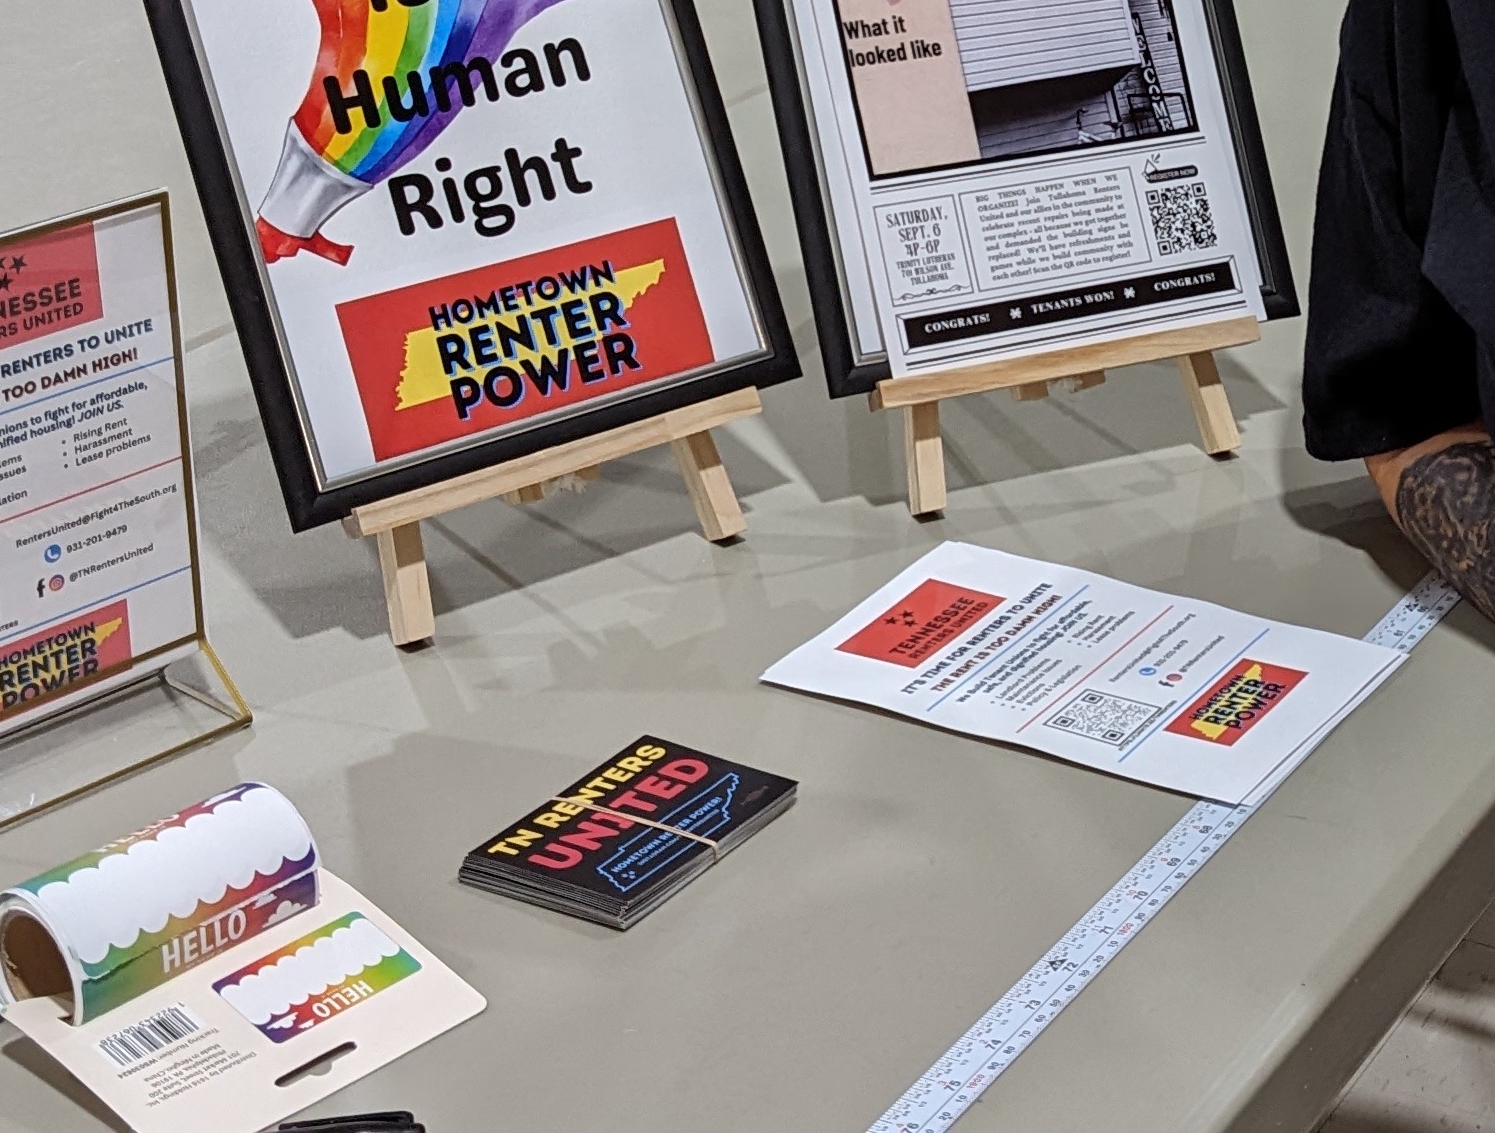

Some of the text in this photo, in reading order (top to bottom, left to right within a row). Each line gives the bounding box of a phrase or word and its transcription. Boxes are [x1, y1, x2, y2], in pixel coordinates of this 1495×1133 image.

[842, 15, 906, 40] What it
[848, 39, 941, 67] looked like
[322, 36, 591, 135] Human
[389, 137, 592, 236] Right
[975, 174, 1118, 202] BIG THINGS HAPPEN WHEN WE
[976, 183, 1120, 212] ORGANIZE! Join Tullahoma Renters
[979, 212, 1004, 222] United
[1004, 210, 1018, 218] and
[1032, 204, 1052, 213] allies
[1060, 201, 1073, 209] the
[1073, 195, 1114, 209] community
[898, 222, 941, 242] SEPT. 6
[904, 239, 939, 256] 4P-6P
[991, 271, 1009, 280] each
[1032, 264, 1050, 273] Scan
[1050, 262, 1063, 270] the
[1063, 260, 1075, 268] QR
[1075, 257, 1092, 266] code
[1101, 251, 1132, 264] register!
[1154, 272, 1214, 290] CONGRATS!
[22, 301, 84, 330] UNITED
[428, 259, 615, 332] HOMETOWN
[1031, 290, 1114, 313] TENANTS WON!
[438, 290, 630, 376] RENTER
[924, 313, 989, 332] CONGRATS!
[0, 317, 153, 378] RENTERS TO UNITE
[1, 345, 138, 403] TOO DAMN HIGH!
[451, 337, 642, 422] POWER
[29, 378, 148, 426] to fight for affordable,
[29, 398, 124, 439] housing! JOIN US.
[72, 416, 128, 444] Rising Rent
[73, 426, 133, 454] Harassment
[75, 432, 152, 466] Lease problems
[65, 523, 128, 554] 931-201-9479
[68, 542, 154, 583] @TNRentersUnited
[887, 595, 977, 656] TENNESSEE
[899, 582, 1054, 694] IT'S TIME FOR RENTERS TO UNITE
[905, 600, 991, 660] RENTERS UNITED
[929, 593, 1064, 692] THE RENT IS TOO DAMN HIGH!
[1187, 673, 1249, 720] HOMETOWN
[1200, 677, 1268, 725] RENTER
[1220, 681, 1289, 730] POWER
[488, 745, 664, 854] TN RENTERS
[530, 759, 706, 867] UNITED
[608, 838, 663, 873] HOMETOWN
[160, 909, 248, 974] HELLO
[311, 979, 375, 1020] HELLO
